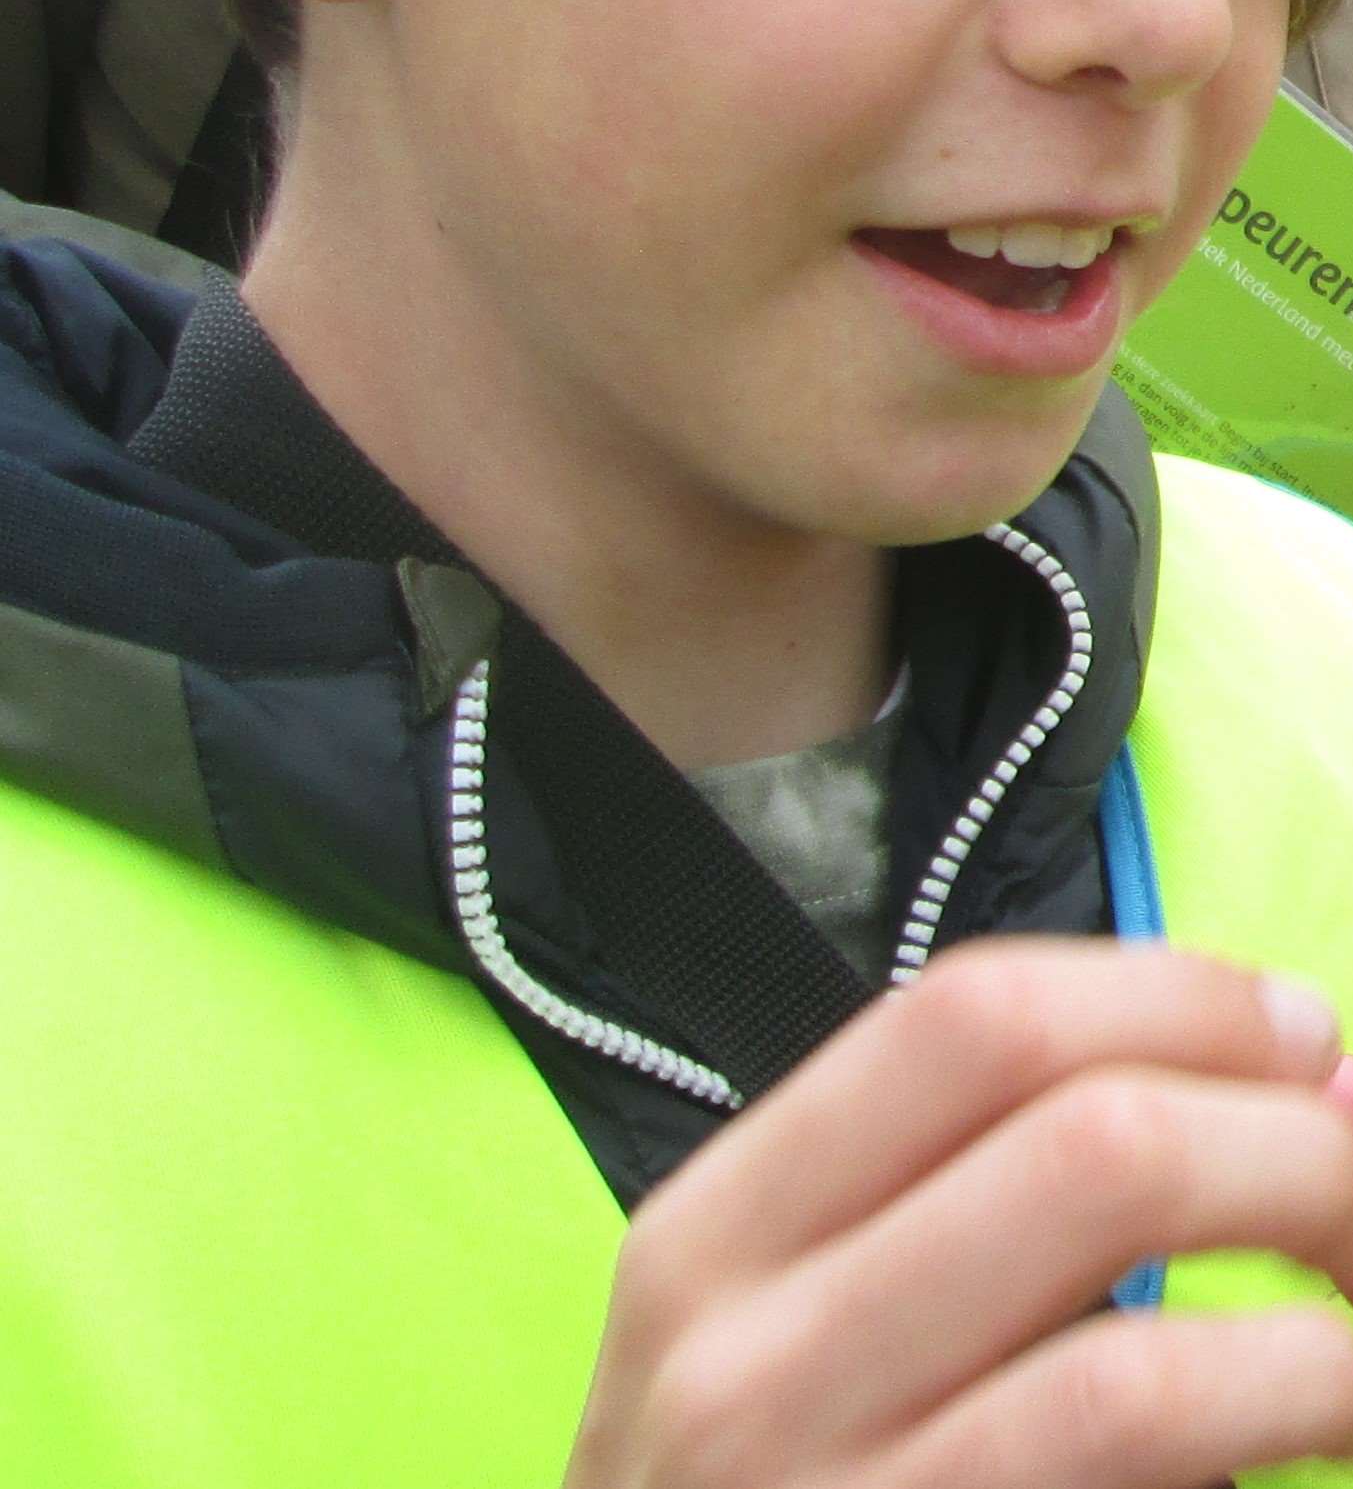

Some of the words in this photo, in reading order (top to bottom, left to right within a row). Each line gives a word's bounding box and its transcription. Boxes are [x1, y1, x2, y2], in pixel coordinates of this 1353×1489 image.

[1227, 260, 1324, 341] Nederland
[1138, 382, 1163, 404] dan
[1163, 401, 1190, 427] volg
